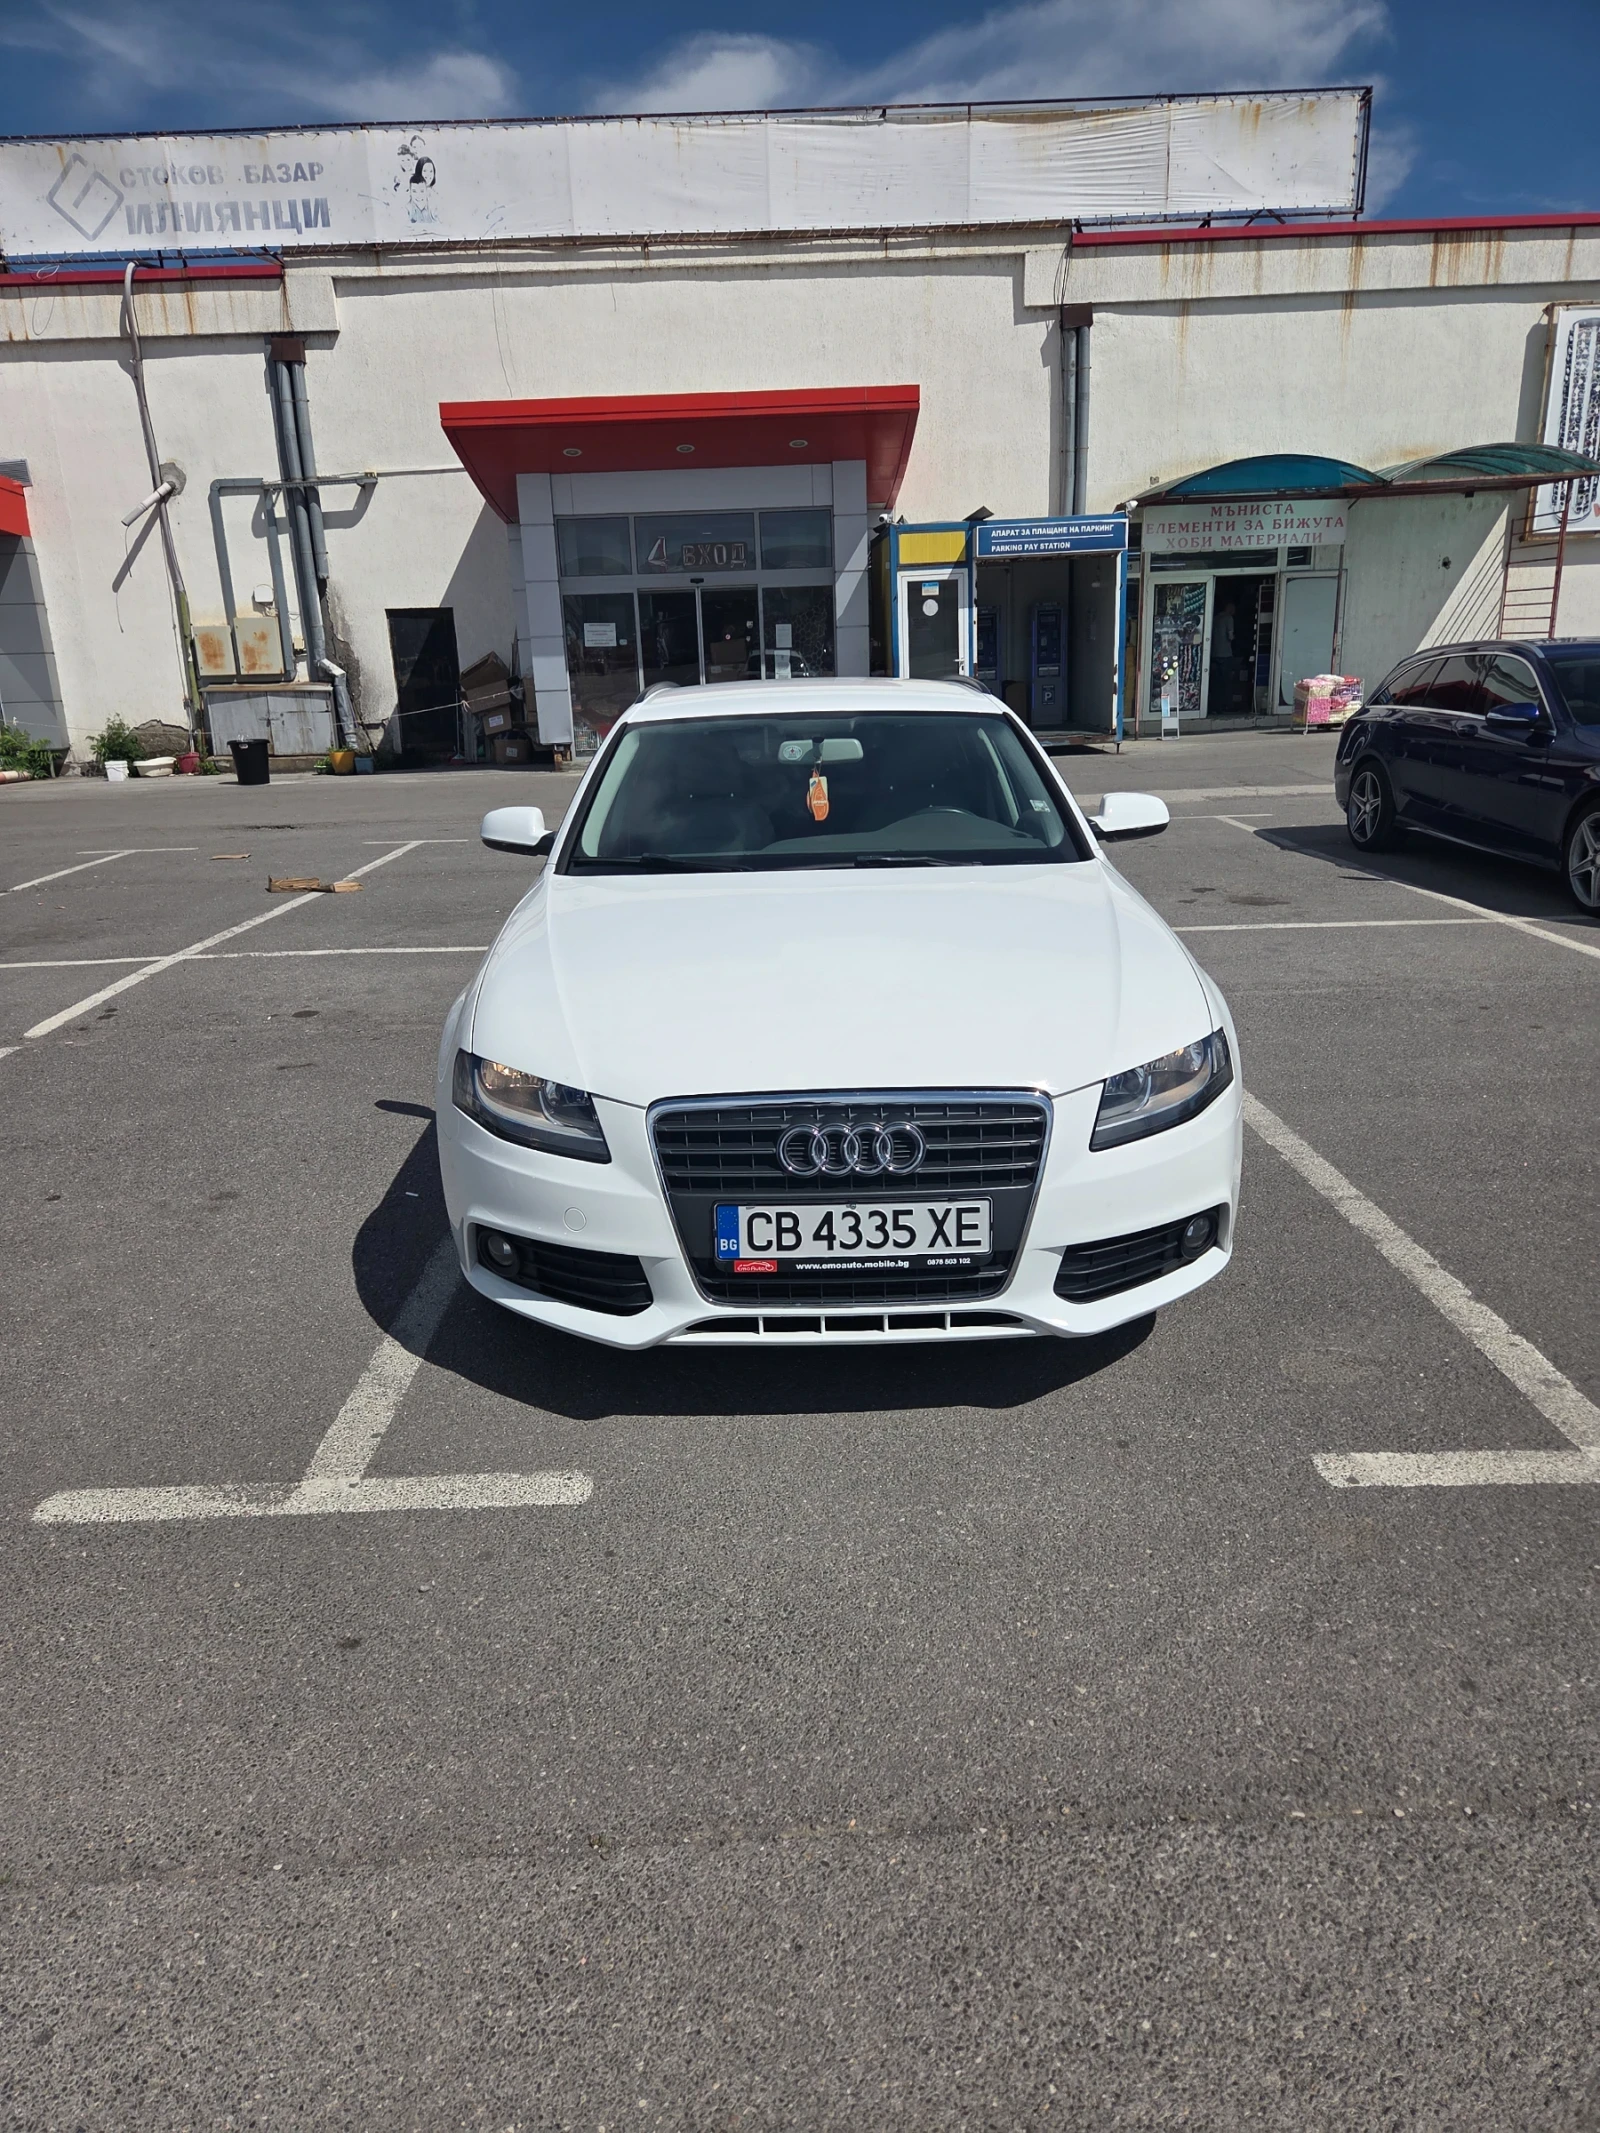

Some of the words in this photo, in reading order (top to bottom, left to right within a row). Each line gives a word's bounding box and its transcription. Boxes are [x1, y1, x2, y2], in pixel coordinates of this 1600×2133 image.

[244, 161, 324, 184] БАЗАР
[125, 197, 331, 235] ИЛИЯНЦИ
[1210, 503, 1294, 517] МЪНИСТА
[991, 529, 1020, 537] АПАРАТ
[1021, 528, 1030, 536] ЗА
[1032, 526, 1068, 535] ПЛАЩАНЕ
[1069, 525, 1080, 533] НА
[1081, 524, 1114, 533] ПАРКИНГ
[1146, 520, 1236, 534] ЕЛЕМЕНТИ
[1244, 519, 1264, 531] ЗА
[1272, 516, 1344, 530] БИЖУТА
[991, 544, 1022, 552] PARKING
[1024, 543, 1038, 551] PAY
[1040, 541, 1070, 550] STATION
[1166, 536, 1212, 549] ХОБИ
[1220, 532, 1323, 547] МАТЕРИАЛИ
[683, 543, 747, 568] ВХОД
[747, 1211, 802, 1252] CB
[812, 1209, 917, 1251] 4335
[927, 1207, 982, 1248] XE
[720, 1239, 738, 1251] BG
[795, 1259, 909, 1270] www.emoauto.mobile.bg
